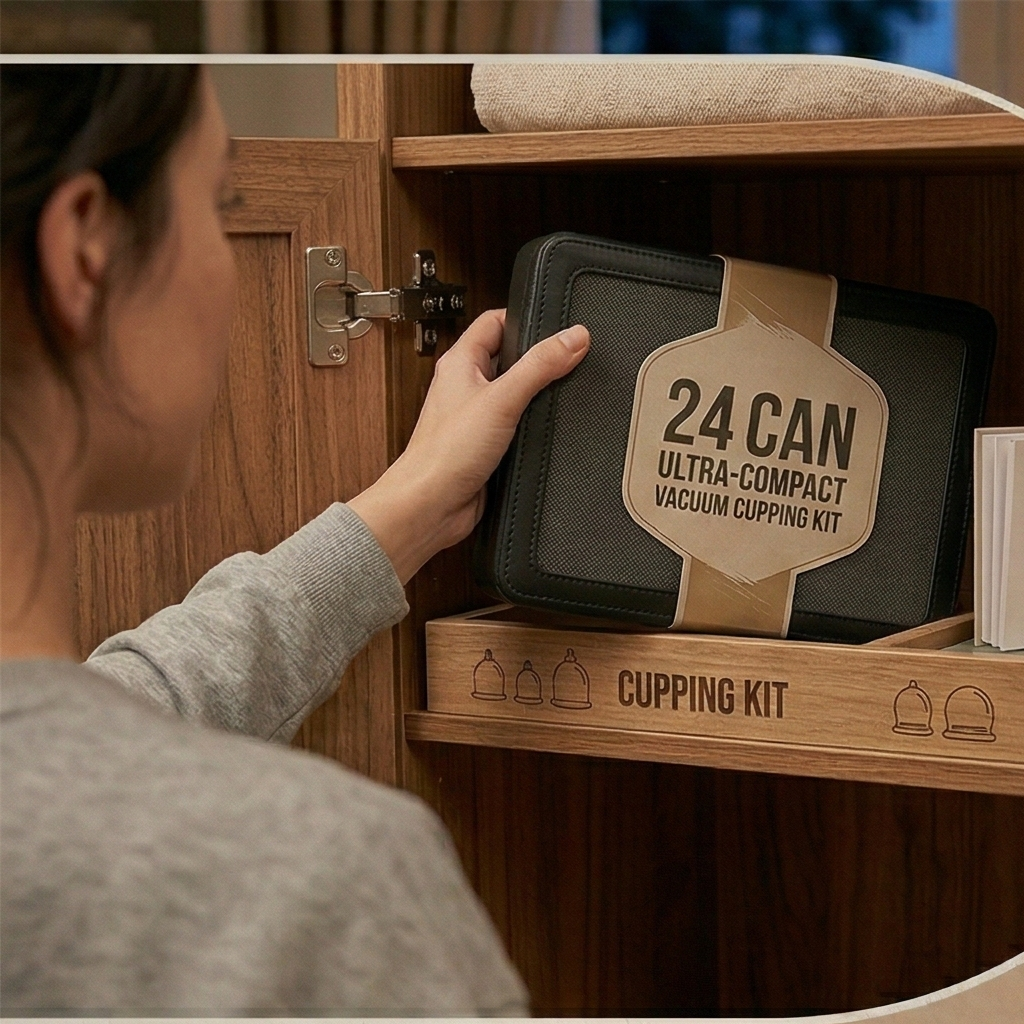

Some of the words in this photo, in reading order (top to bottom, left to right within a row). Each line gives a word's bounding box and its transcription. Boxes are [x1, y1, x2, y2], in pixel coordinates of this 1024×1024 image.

[663, 378, 735, 451] 24
[746, 392, 857, 470] CAN
[657, 450, 847, 505] ULTRA-COMPACT
[655, 484, 729, 516] VACUUM
[733, 498, 808, 528] CUPPING
[812, 510, 843, 533] KIT
[617, 669, 735, 714] CUPPING
[743, 678, 789, 719] KIT
